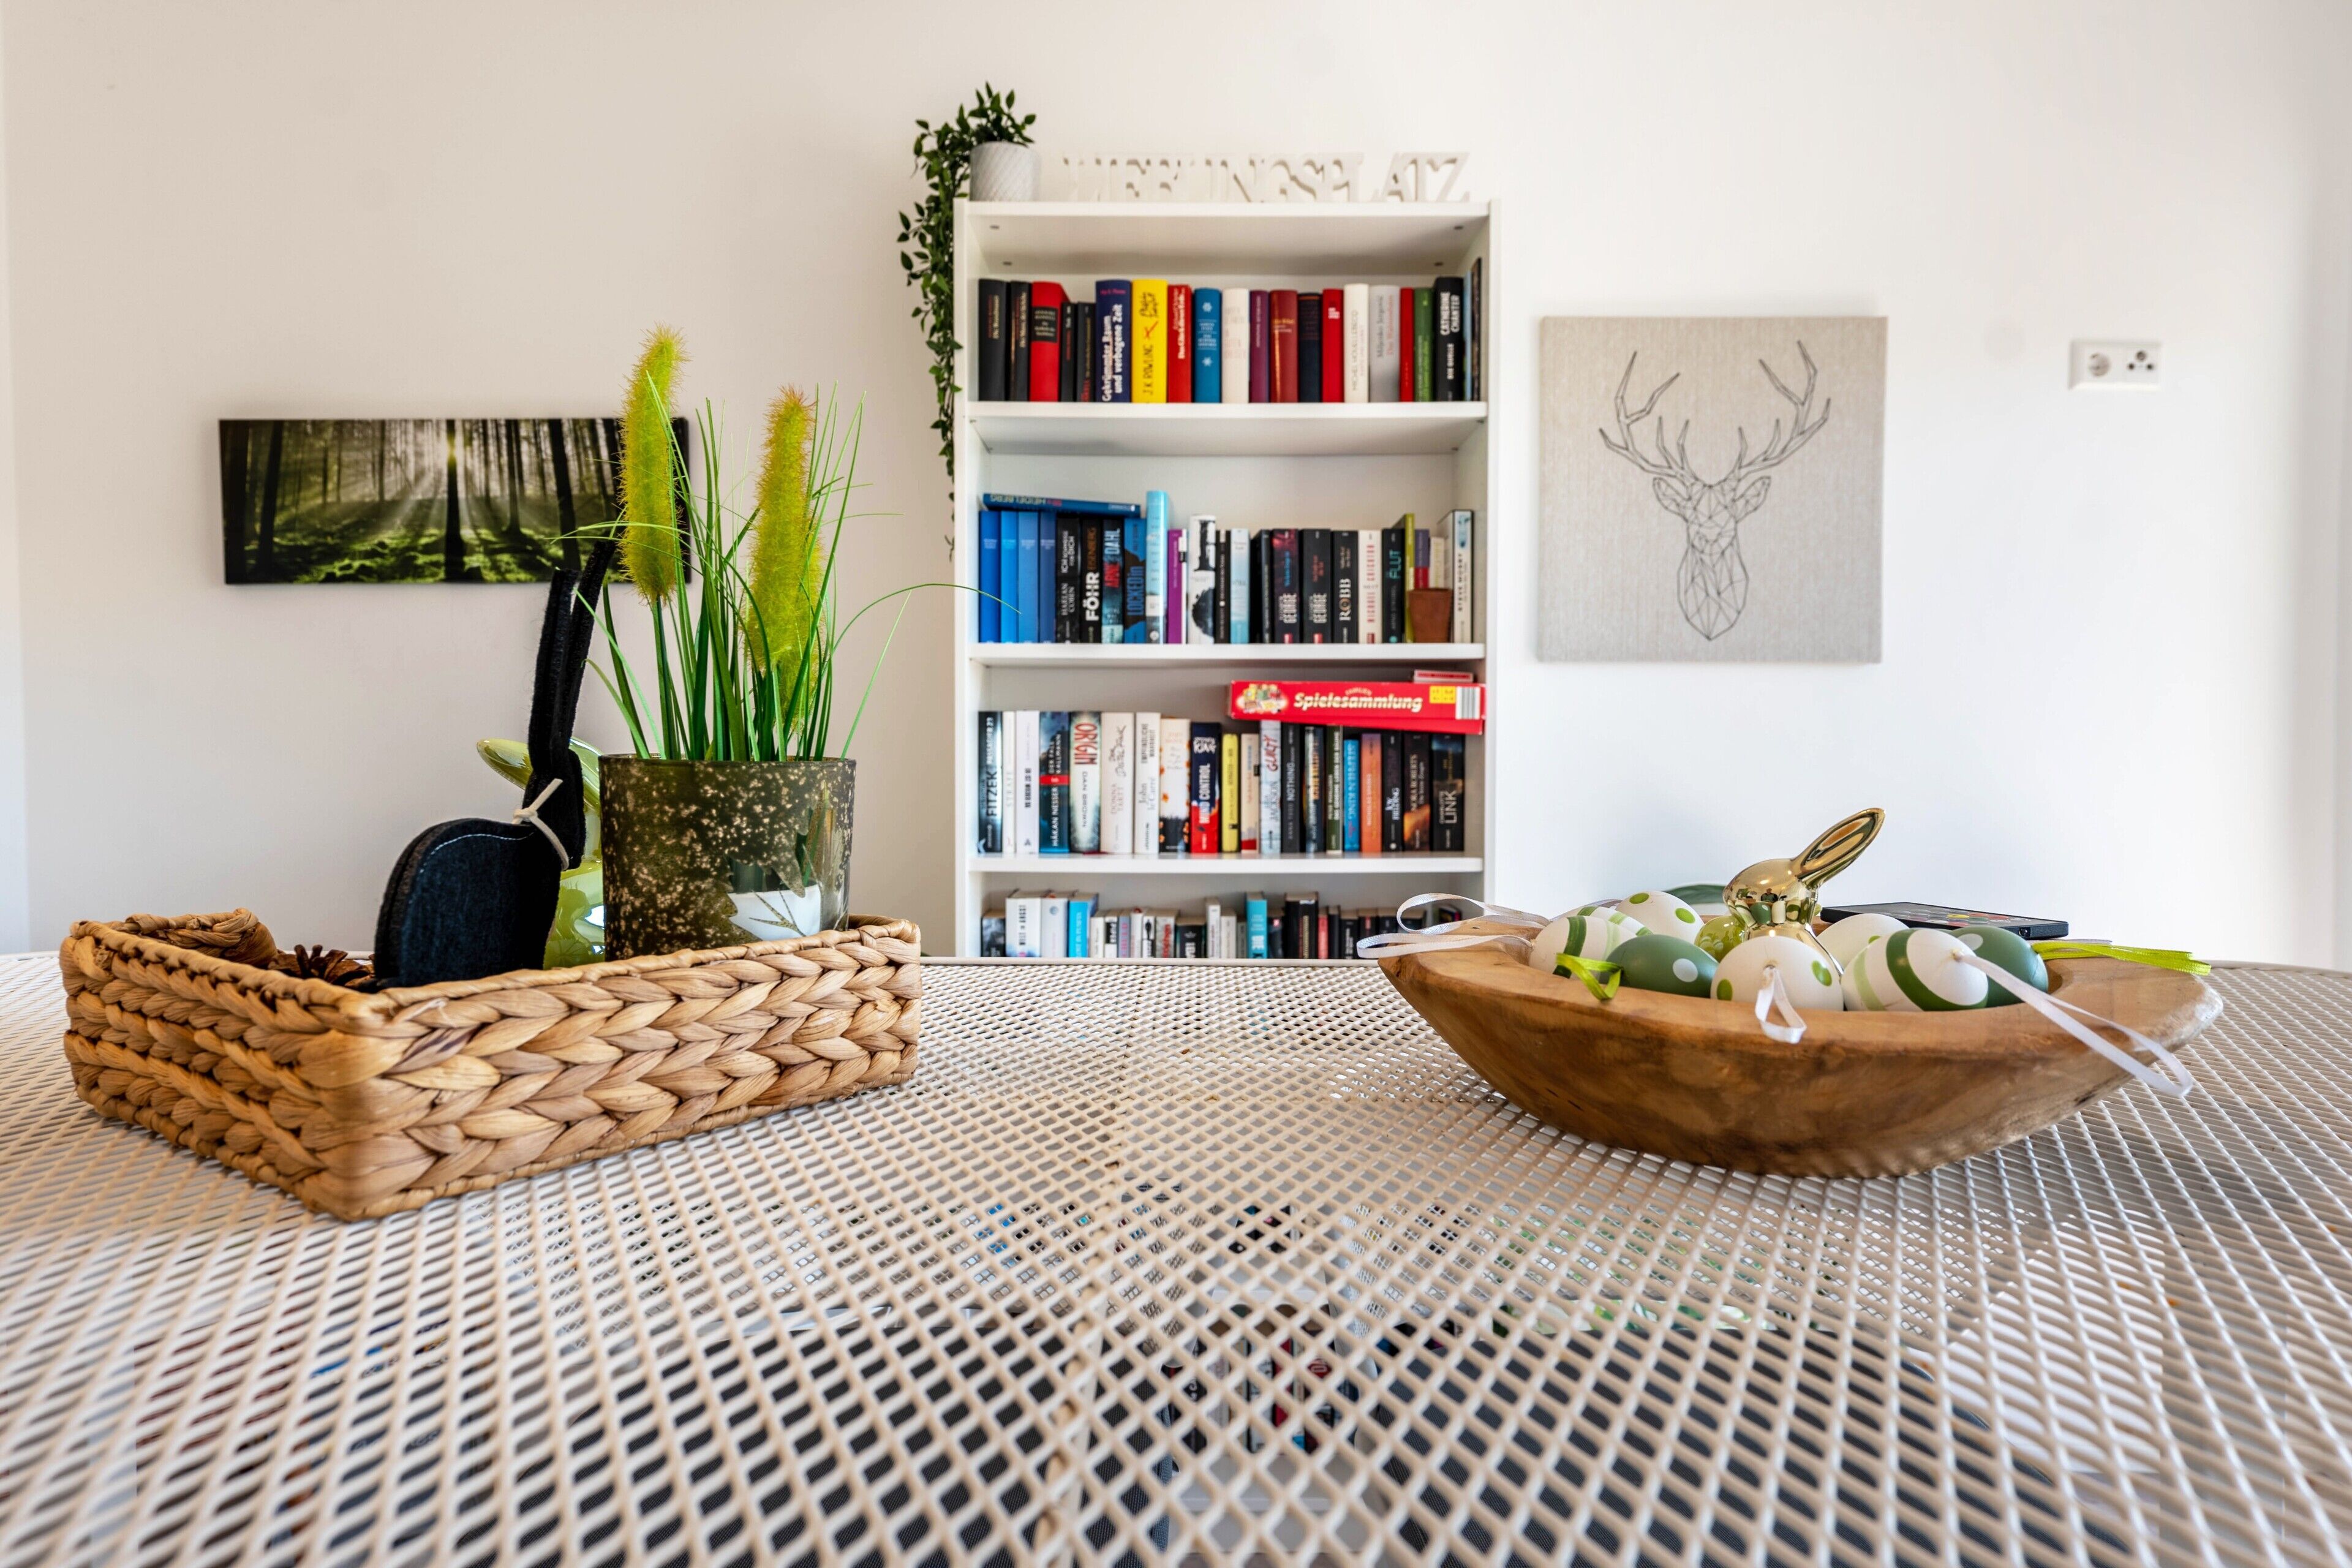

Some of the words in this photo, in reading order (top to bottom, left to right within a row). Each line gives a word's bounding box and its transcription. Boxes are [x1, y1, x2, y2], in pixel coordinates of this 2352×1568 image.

[1113, 304, 1122, 323] Zeit
[1440, 292, 1451, 336] CATHERINE
[1450, 295, 1460, 333] CHANTER
[1114, 325, 1125, 373] verbogene
[1114, 375, 1122, 394] und
[1104, 528, 1120, 555] DAHL
[1103, 561, 1120, 588] ARNE
[1389, 549, 1402, 579] FLUT
[1083, 571, 1099, 622] FÖHR
[1127, 577, 1144, 616] LOCKED
[1338, 578, 1352, 621] ROBB
[1293, 692, 1423, 714] Spielesammlung
[1074, 722, 1098, 765] ORIGIN
[1263, 735, 1278, 771] GUILTY
[986, 770, 998, 817] FITZEK
[1199, 763, 1211, 801] CONTROL
[1286, 762, 1295, 801] NOTHING
[1050, 786, 1059, 815] NESSER
[1199, 801, 1210, 824] MIND
[1348, 791, 1357, 820] KING
[1443, 790, 1458, 824] LINK
[1050, 816, 1059, 846] HÅKAN
